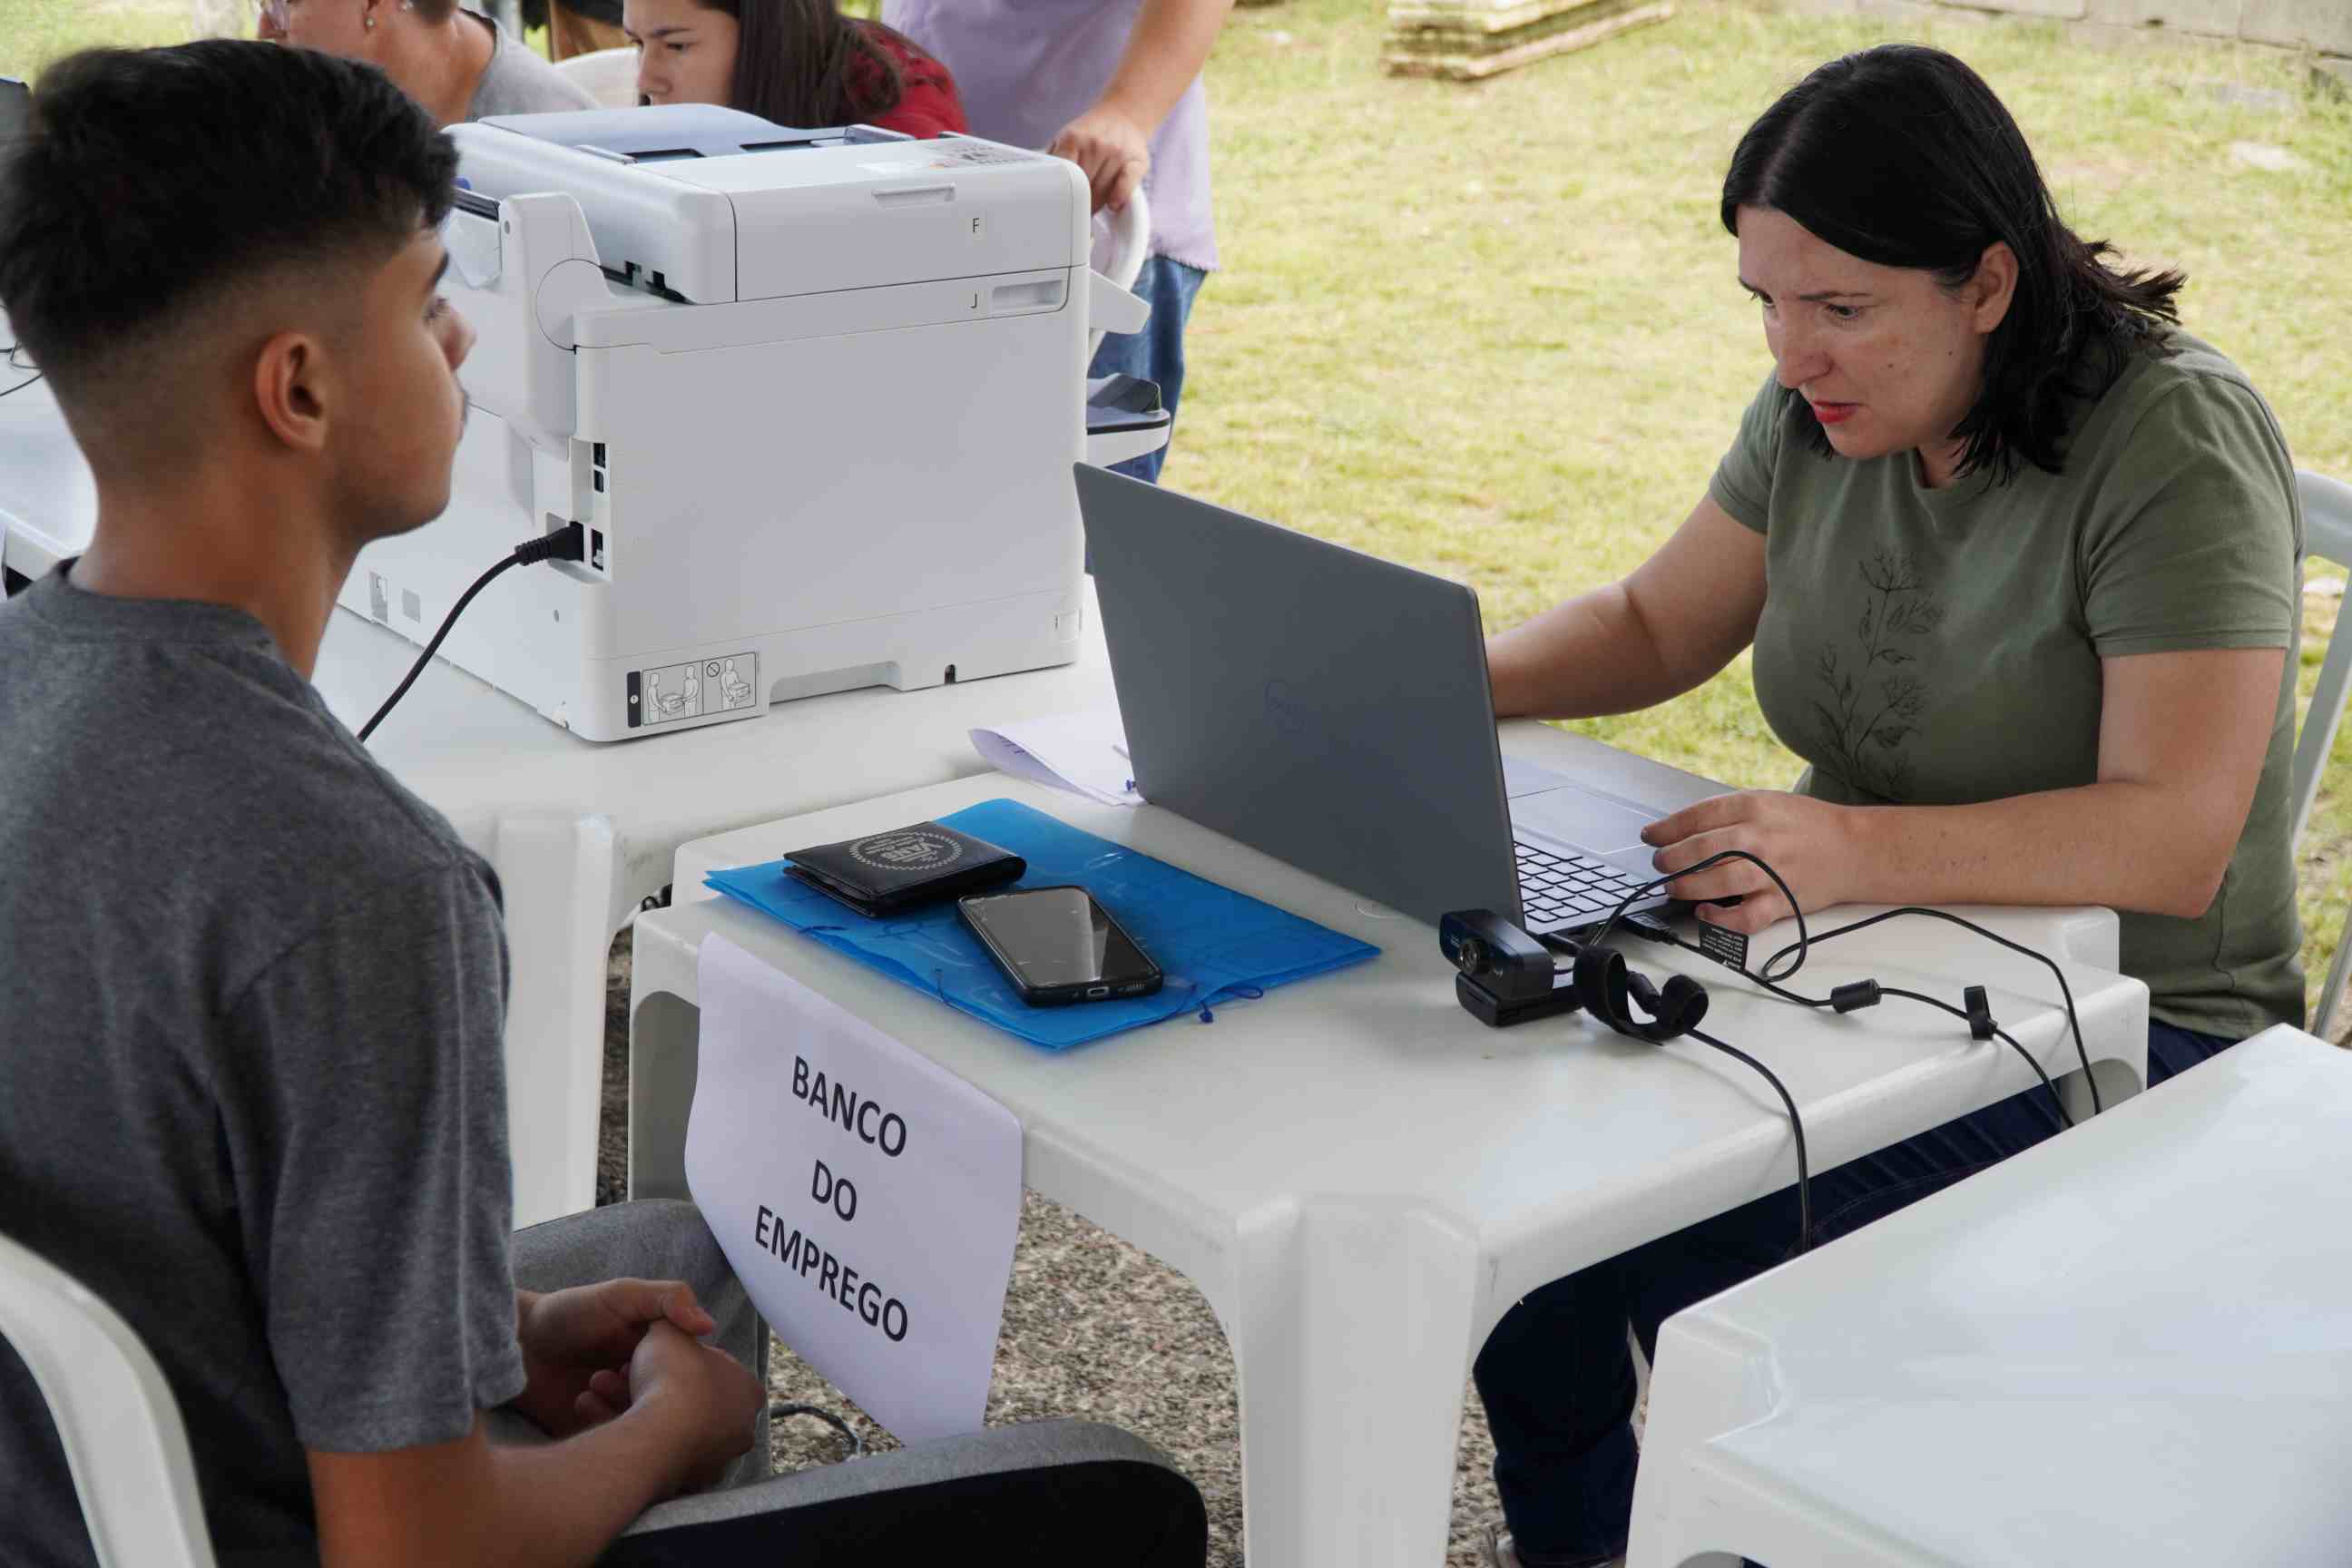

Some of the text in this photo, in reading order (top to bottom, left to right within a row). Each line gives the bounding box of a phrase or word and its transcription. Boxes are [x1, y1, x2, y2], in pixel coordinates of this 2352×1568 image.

[972, 217, 980, 233] F
[970, 292, 978, 309] J
[792, 1055, 906, 1157] BANCO
[811, 1159, 858, 1221] DO
[755, 1204, 908, 1342] EMPREGO
